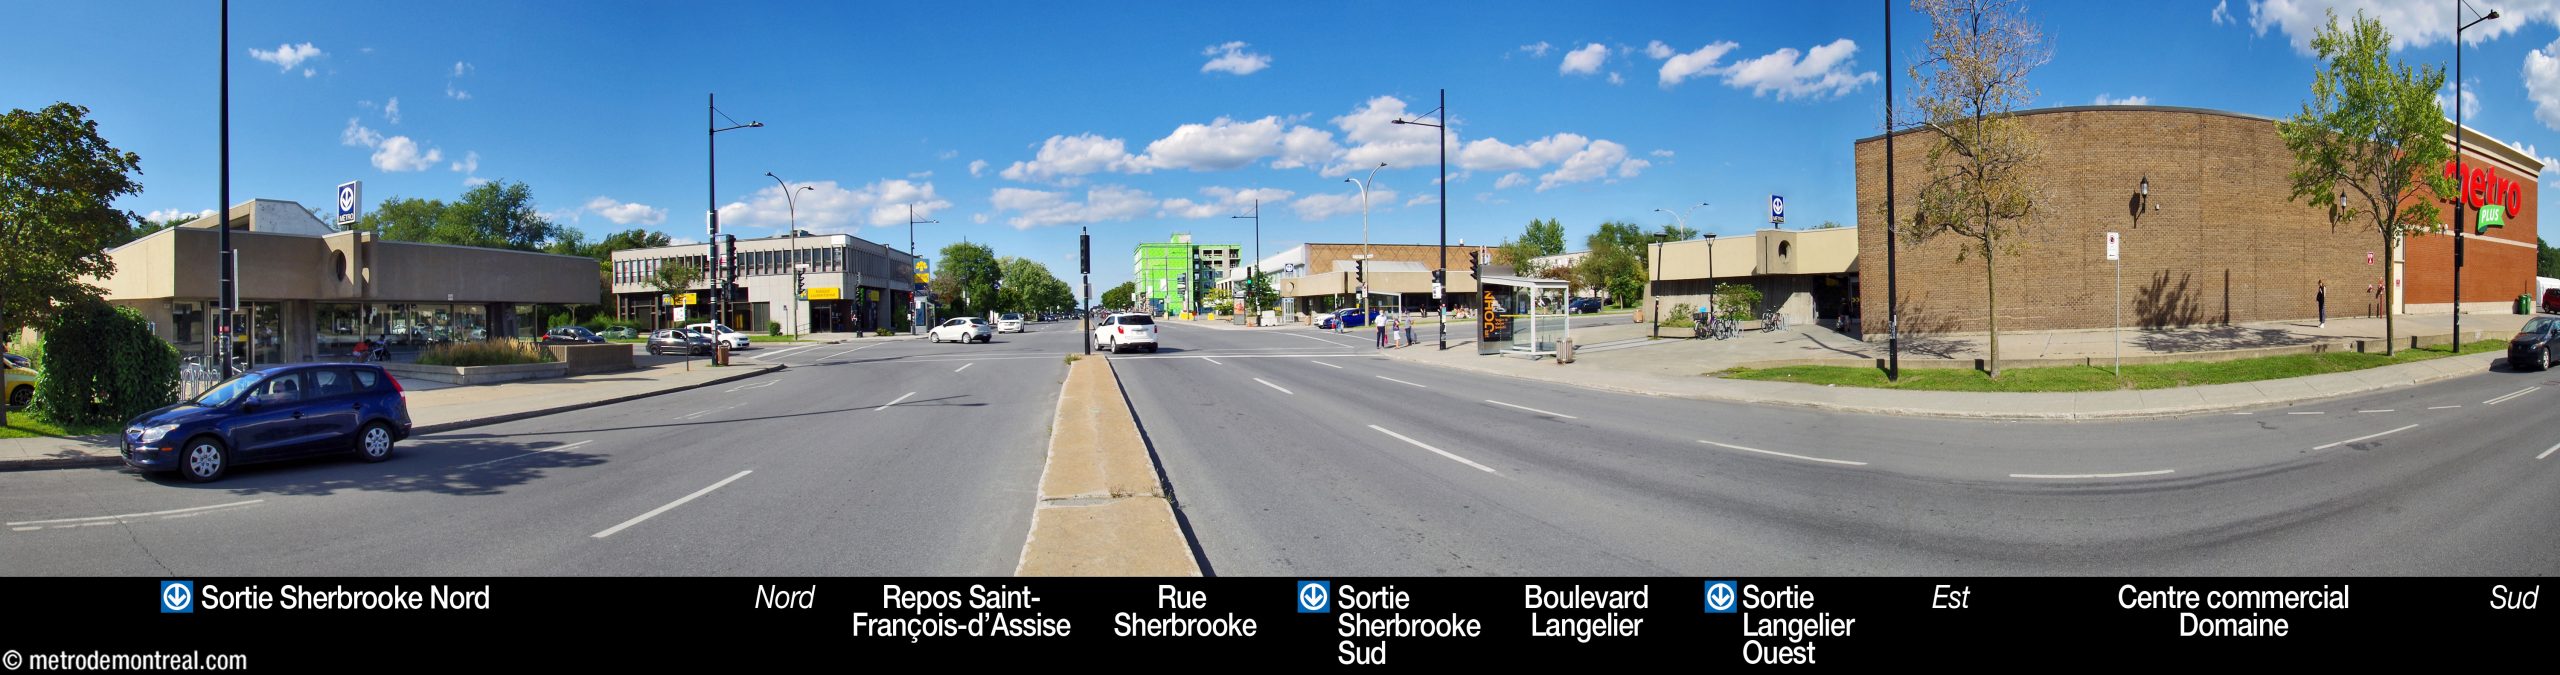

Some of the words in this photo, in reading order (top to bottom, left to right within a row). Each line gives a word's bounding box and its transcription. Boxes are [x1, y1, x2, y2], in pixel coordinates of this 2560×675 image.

[339, 213, 354, 222] METRO
[2481, 208, 2499, 224] PLUS
[1484, 290, 1495, 333] JOHN
